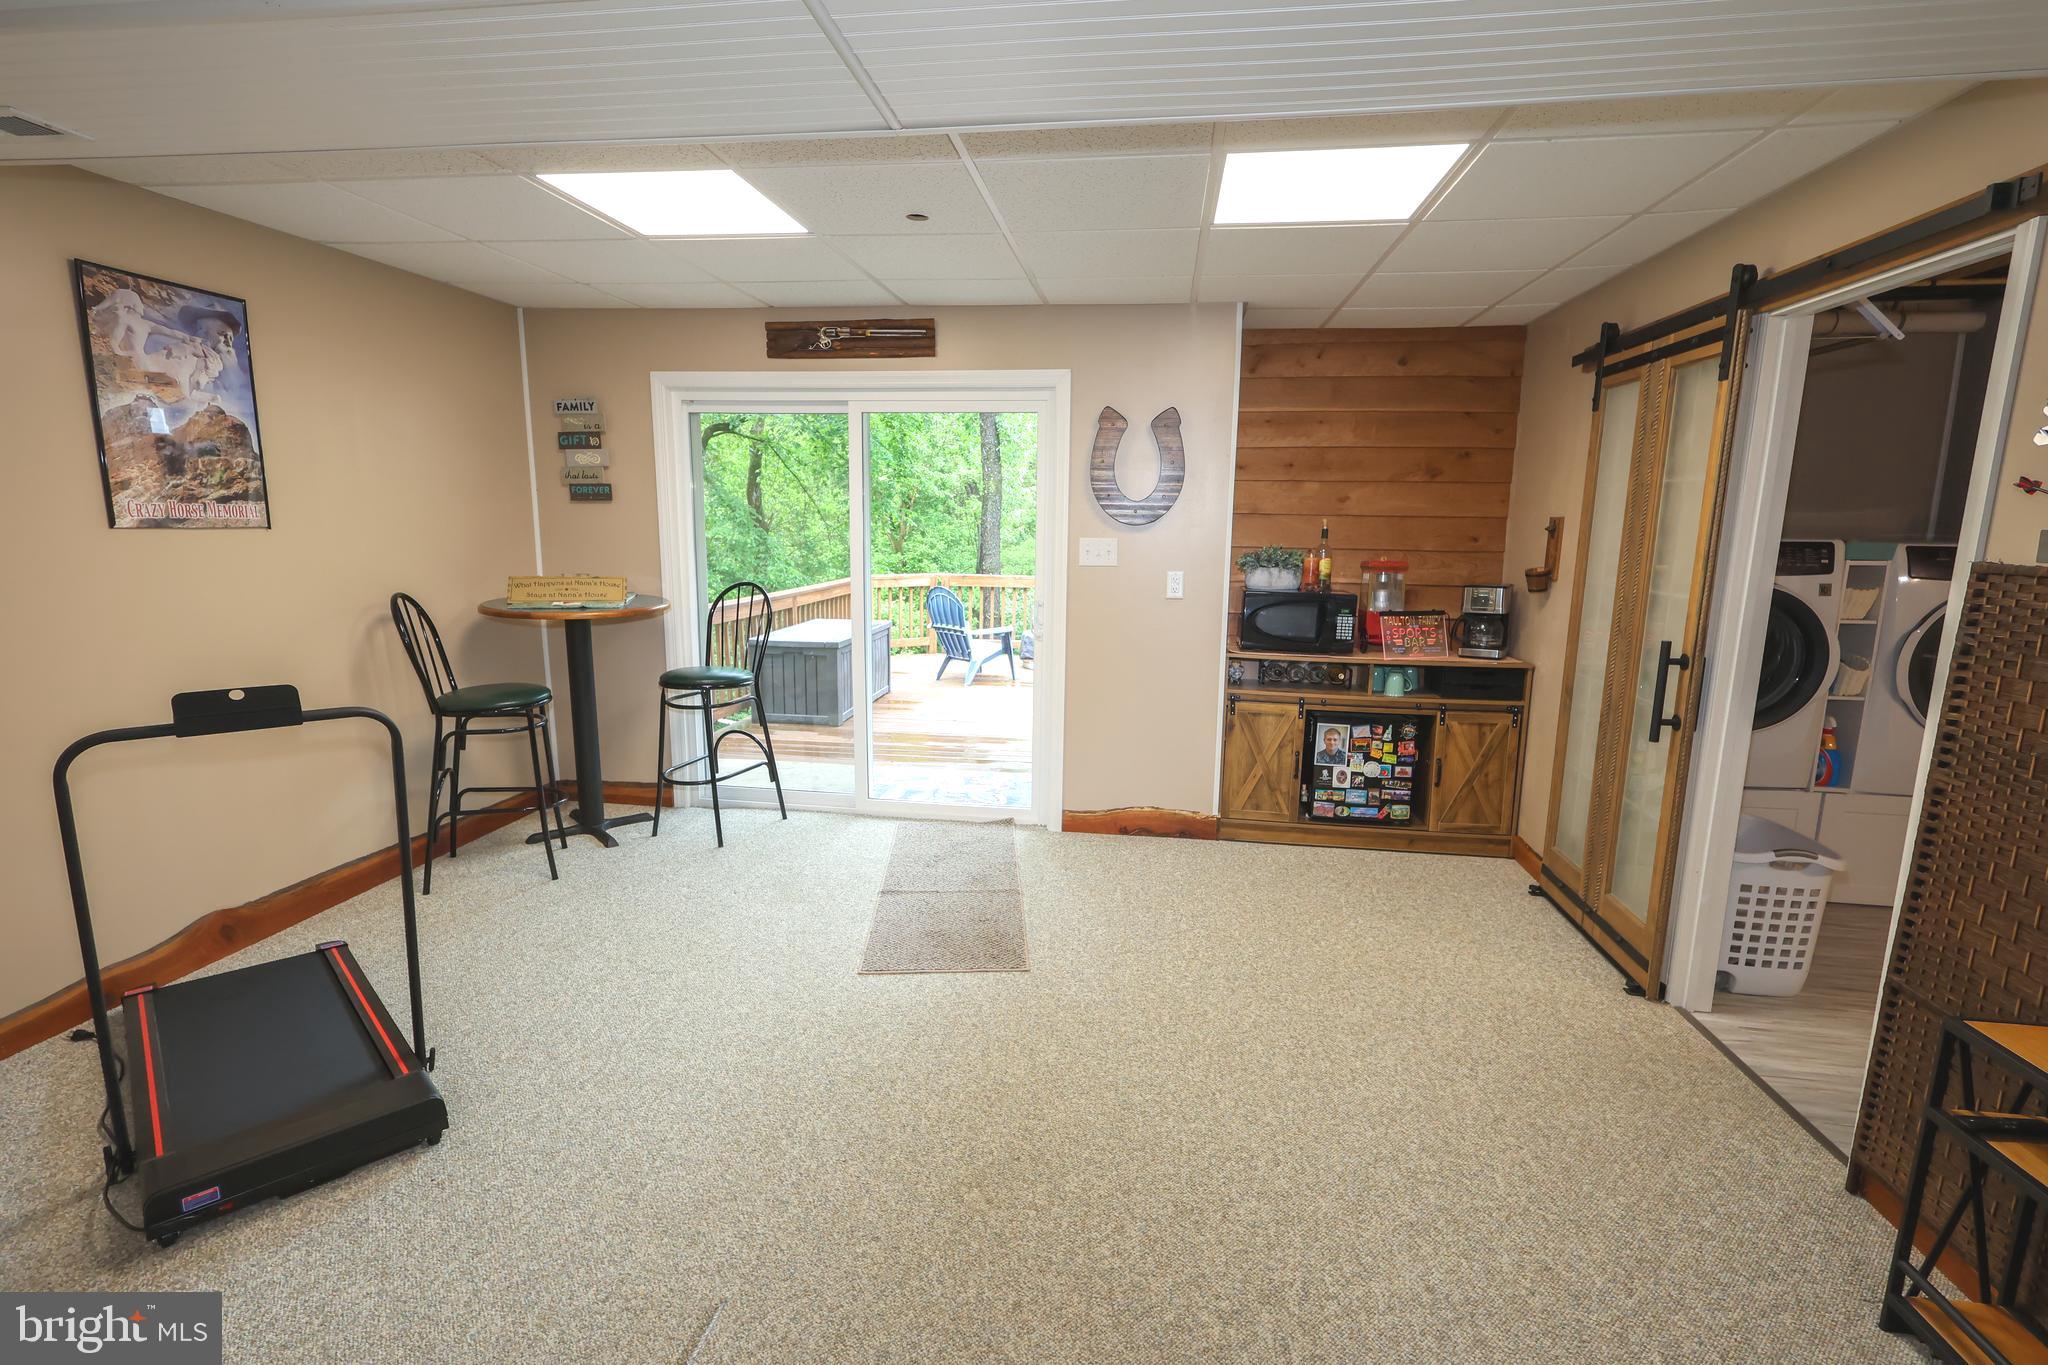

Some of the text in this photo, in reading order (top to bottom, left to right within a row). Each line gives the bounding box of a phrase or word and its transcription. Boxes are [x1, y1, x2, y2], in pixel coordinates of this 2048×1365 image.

[556, 402, 594, 412] FAMILY
[559, 435, 587, 446] GIFT
[564, 469, 600, 480] that lasts
[571, 486, 610, 495] FOREVER
[127, 499, 260, 519] CRAZY HORSE MEMORIAL
[1391, 627, 1437, 639] SPORTS
[1404, 637, 1426, 647] BAR
